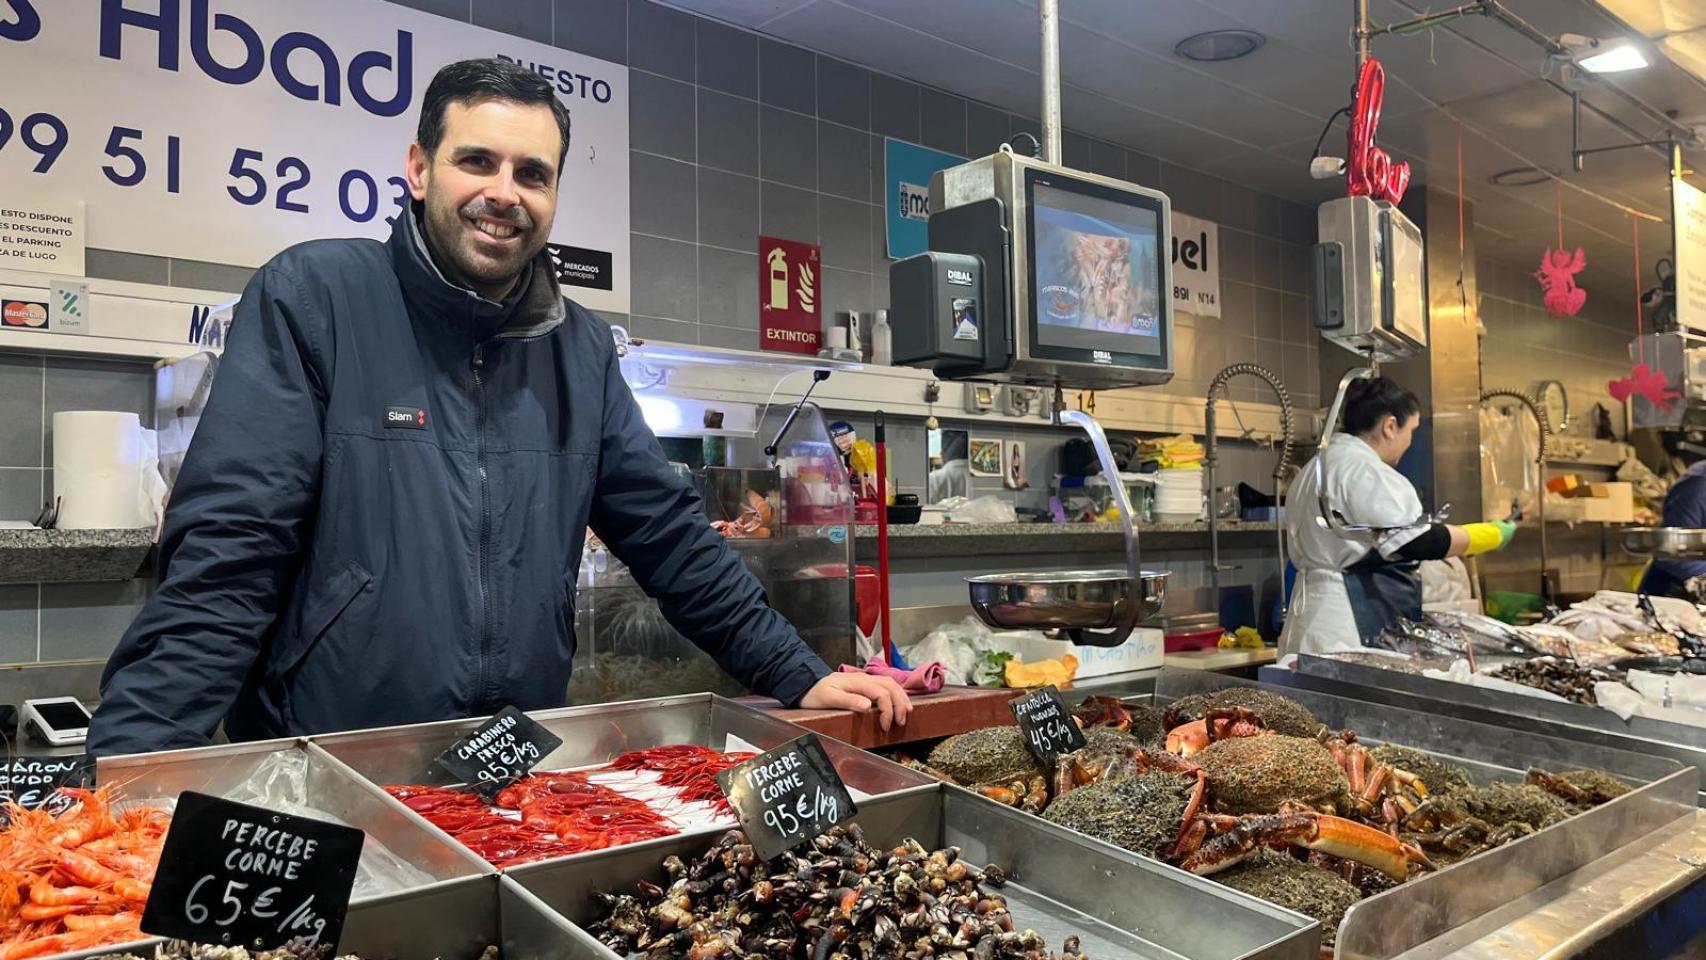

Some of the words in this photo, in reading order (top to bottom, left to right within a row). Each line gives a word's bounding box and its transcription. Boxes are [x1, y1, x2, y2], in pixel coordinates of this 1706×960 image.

[101, 126, 180, 194] 51
[226, 148, 311, 213] 52
[1, 209, 26, 219] ESTO
[29, 212, 73, 224] DISPONE
[12, 223, 73, 237] DESCUENTO
[16, 237, 62, 248] PARKING
[12, 250, 27, 258] DE
[29, 251, 57, 260] LUGO
[564, 261, 599, 274] MERCADOS
[947, 269, 973, 282] DIBAL
[766, 327, 817, 344] EXTINTOR
[1093, 350, 1112, 360] DIBAL
[1077, 390, 1096, 414] 14
[388, 411, 413, 421] Slam
[457, 716, 518, 760] CARABINERO
[476, 733, 516, 763] FRESCO
[744, 751, 802, 790] PERCEBE
[760, 772, 804, 803] CORME
[221, 818, 319, 860] PERCEBE
[224, 848, 302, 880] CORME
